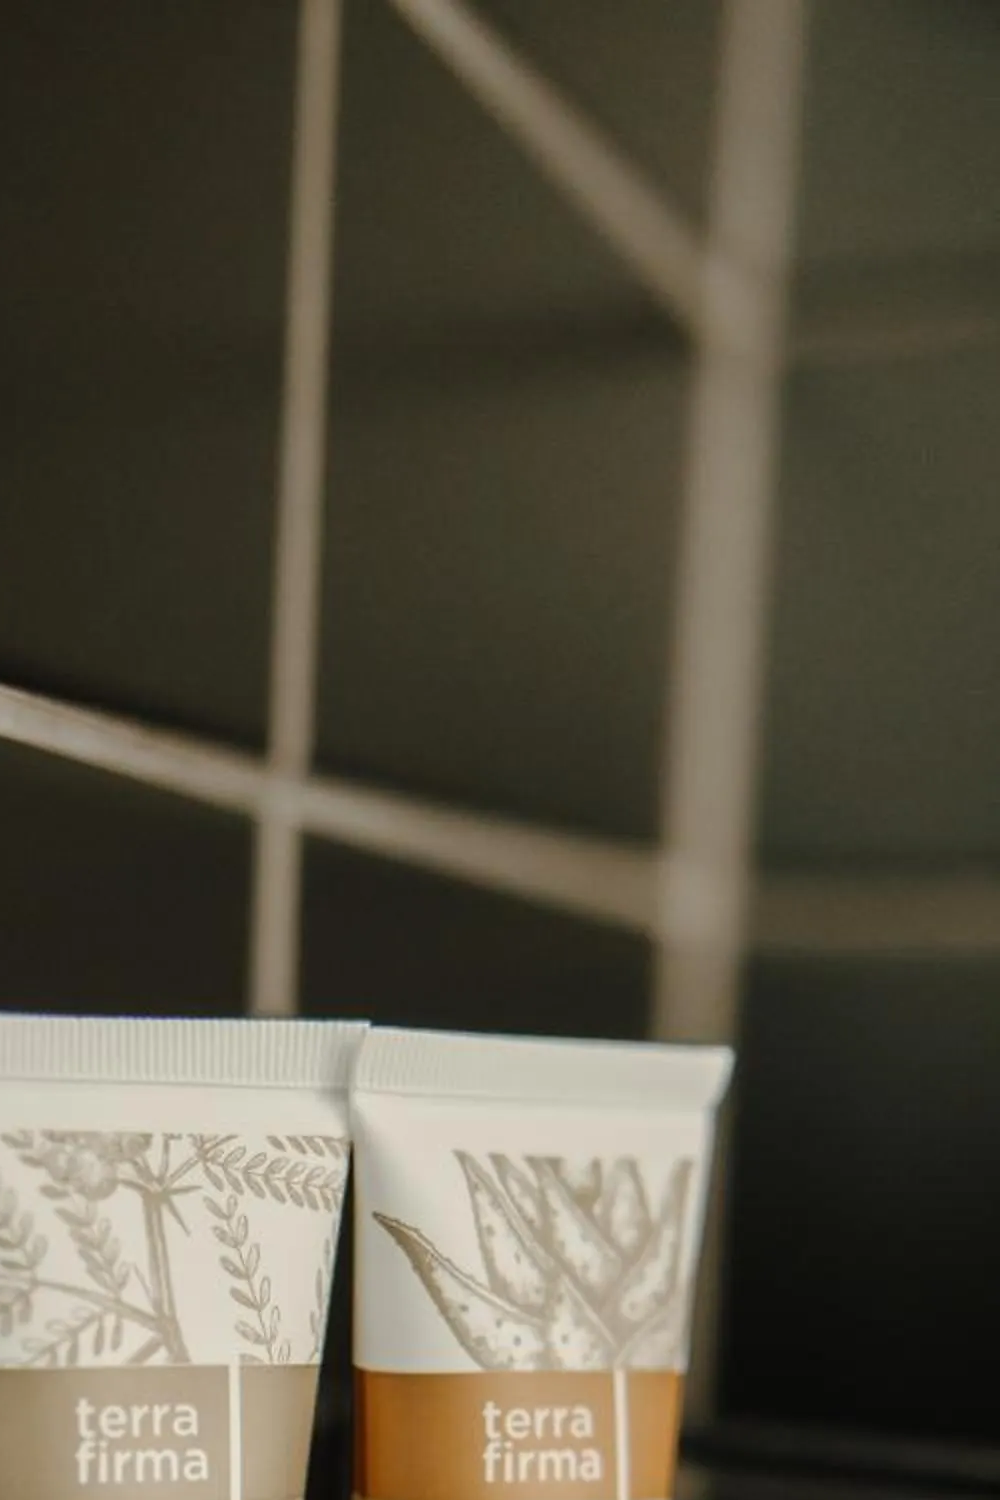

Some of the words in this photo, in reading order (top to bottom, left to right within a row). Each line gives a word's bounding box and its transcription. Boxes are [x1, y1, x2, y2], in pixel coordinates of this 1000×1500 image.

[75, 1399, 198, 1439] terra
[483, 1401, 593, 1440] terra
[75, 1439, 209, 1484] firma
[483, 1440, 603, 1484] firma
